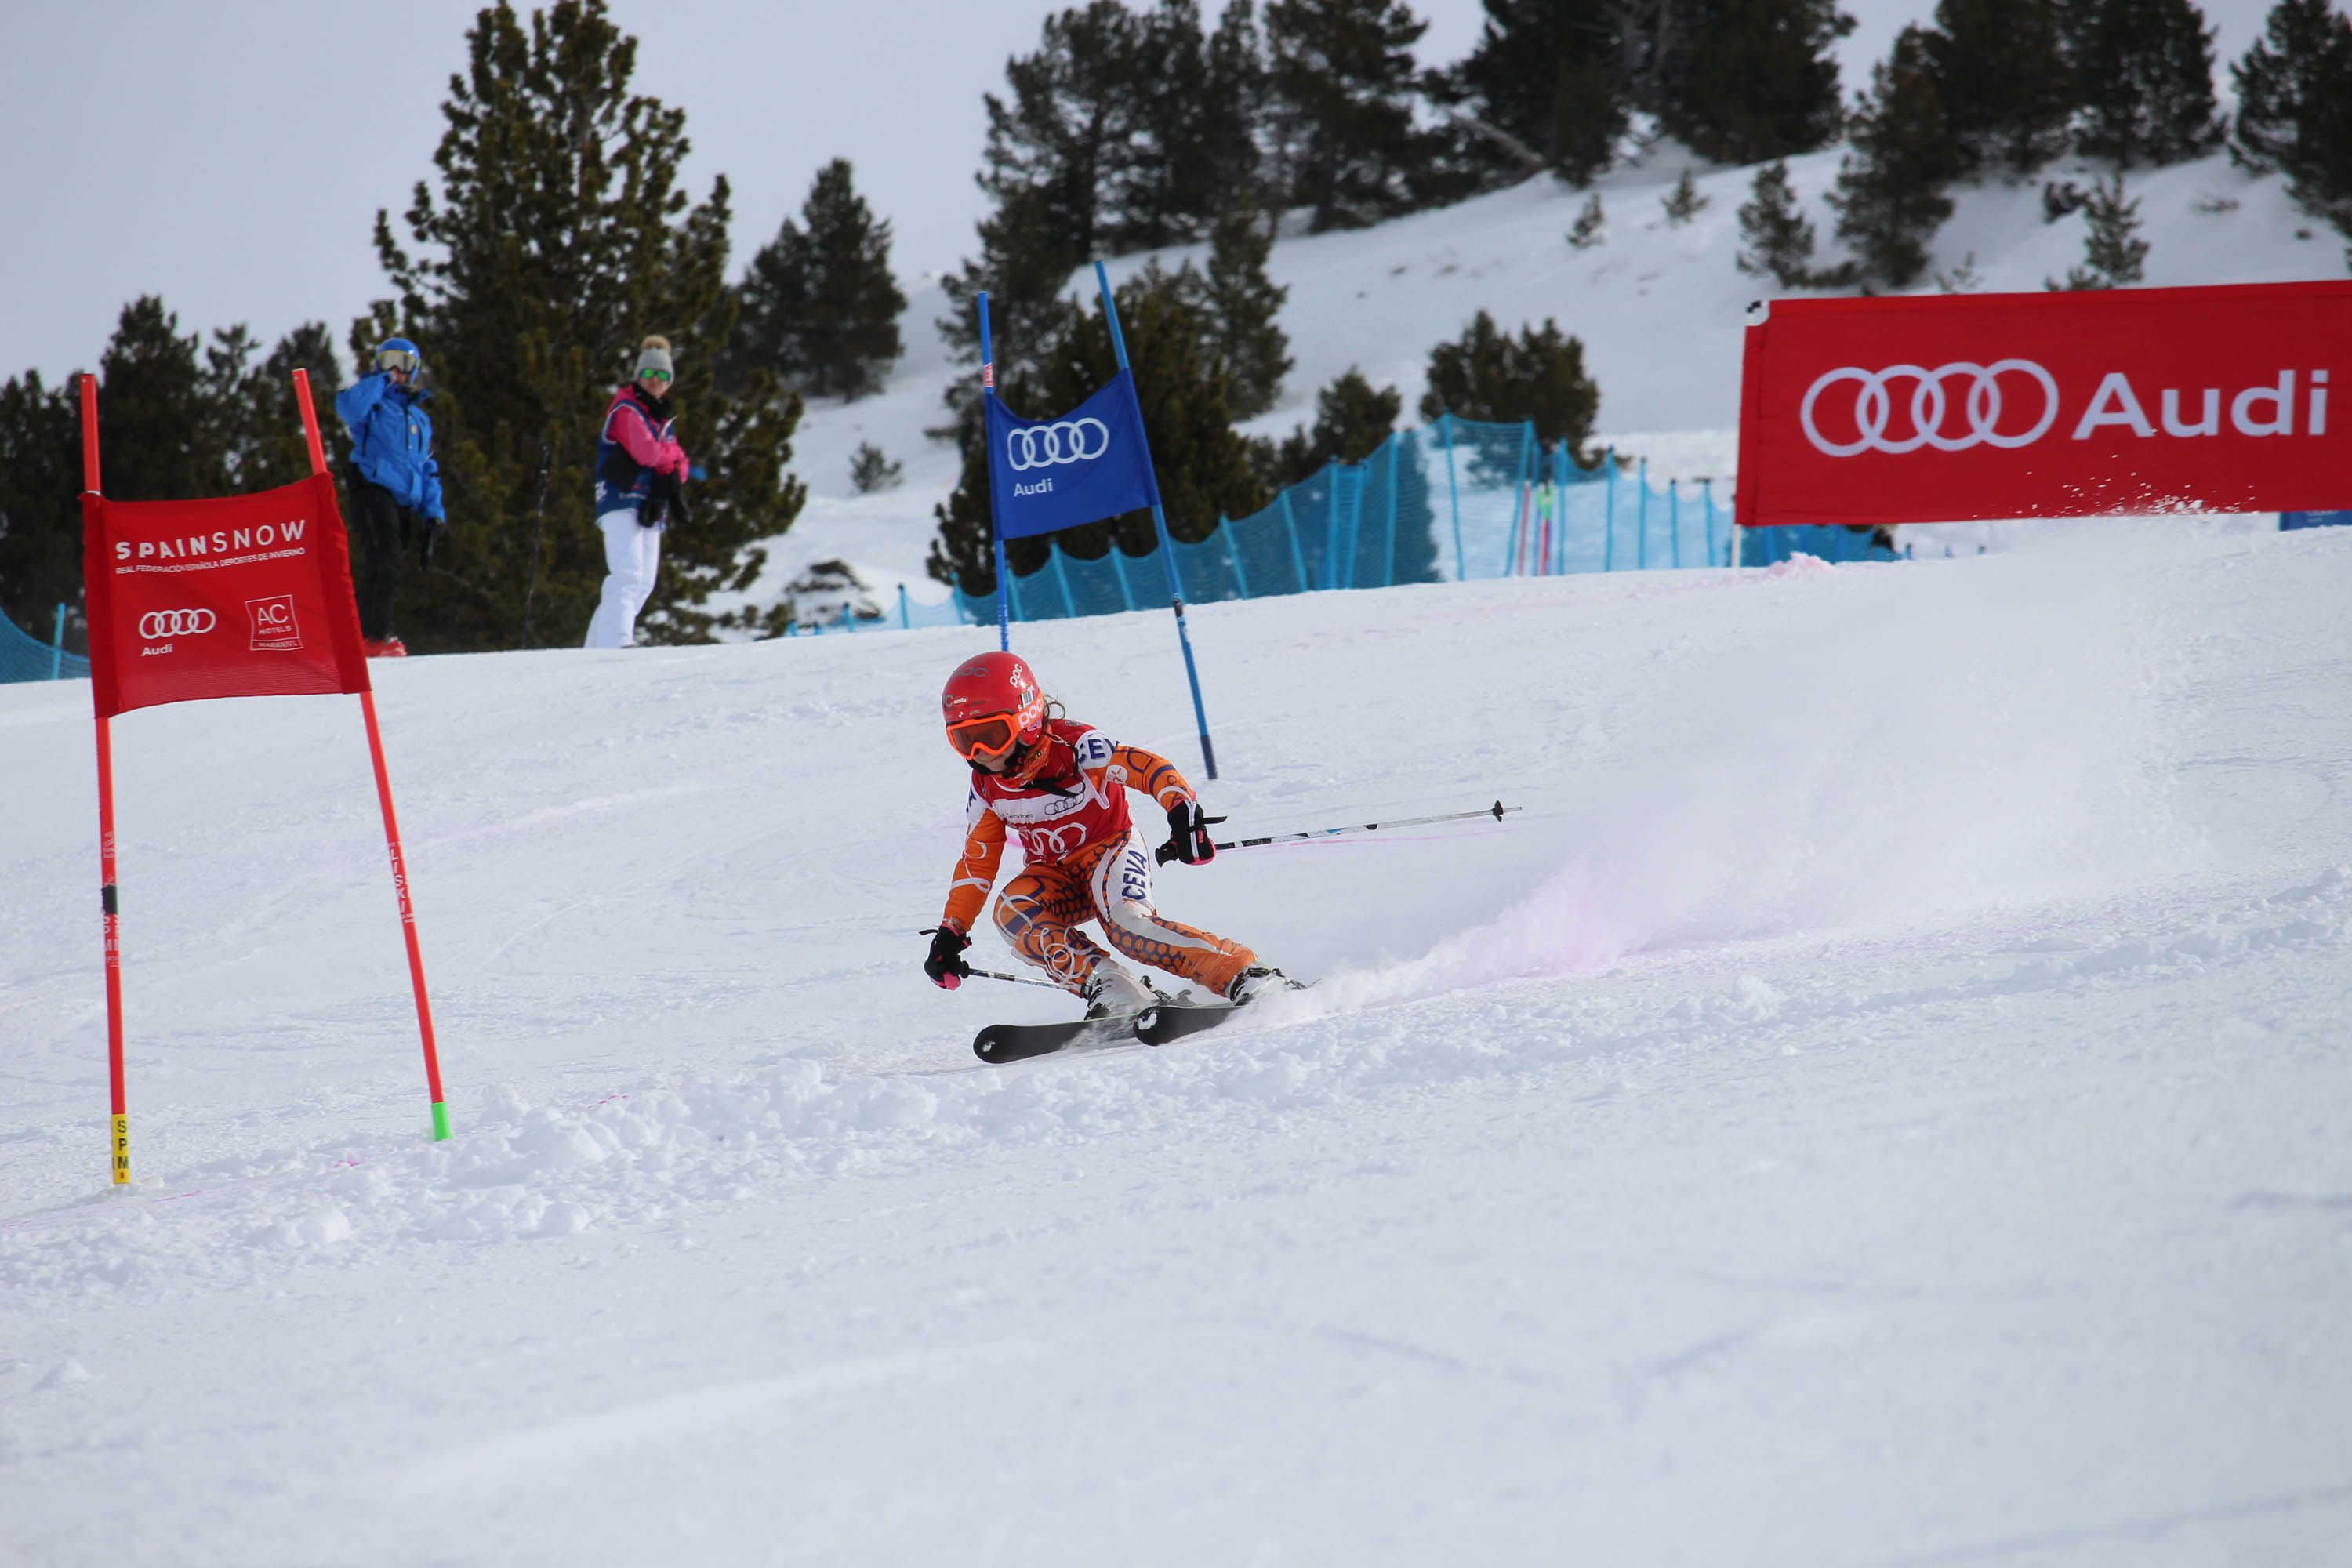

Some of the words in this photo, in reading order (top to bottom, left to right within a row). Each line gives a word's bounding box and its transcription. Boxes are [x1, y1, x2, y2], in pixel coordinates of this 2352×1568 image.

[2071, 369, 2328, 441] Audi
[1014, 478, 1053, 497] Audi
[115, 519, 306, 560] SPAINSNOW
[115, 564, 136, 575] REAL
[220, 554, 257, 567] DEPORTES
[257, 552, 269, 561] DE
[269, 546, 306, 559] INVIERNO
[257, 603, 289, 626] AC
[258, 625, 292, 635] HOTELS
[141, 643, 173, 656] Audi
[1121, 850, 1147, 901] CEVA
[117, 1120, 129, 1170] SPM
